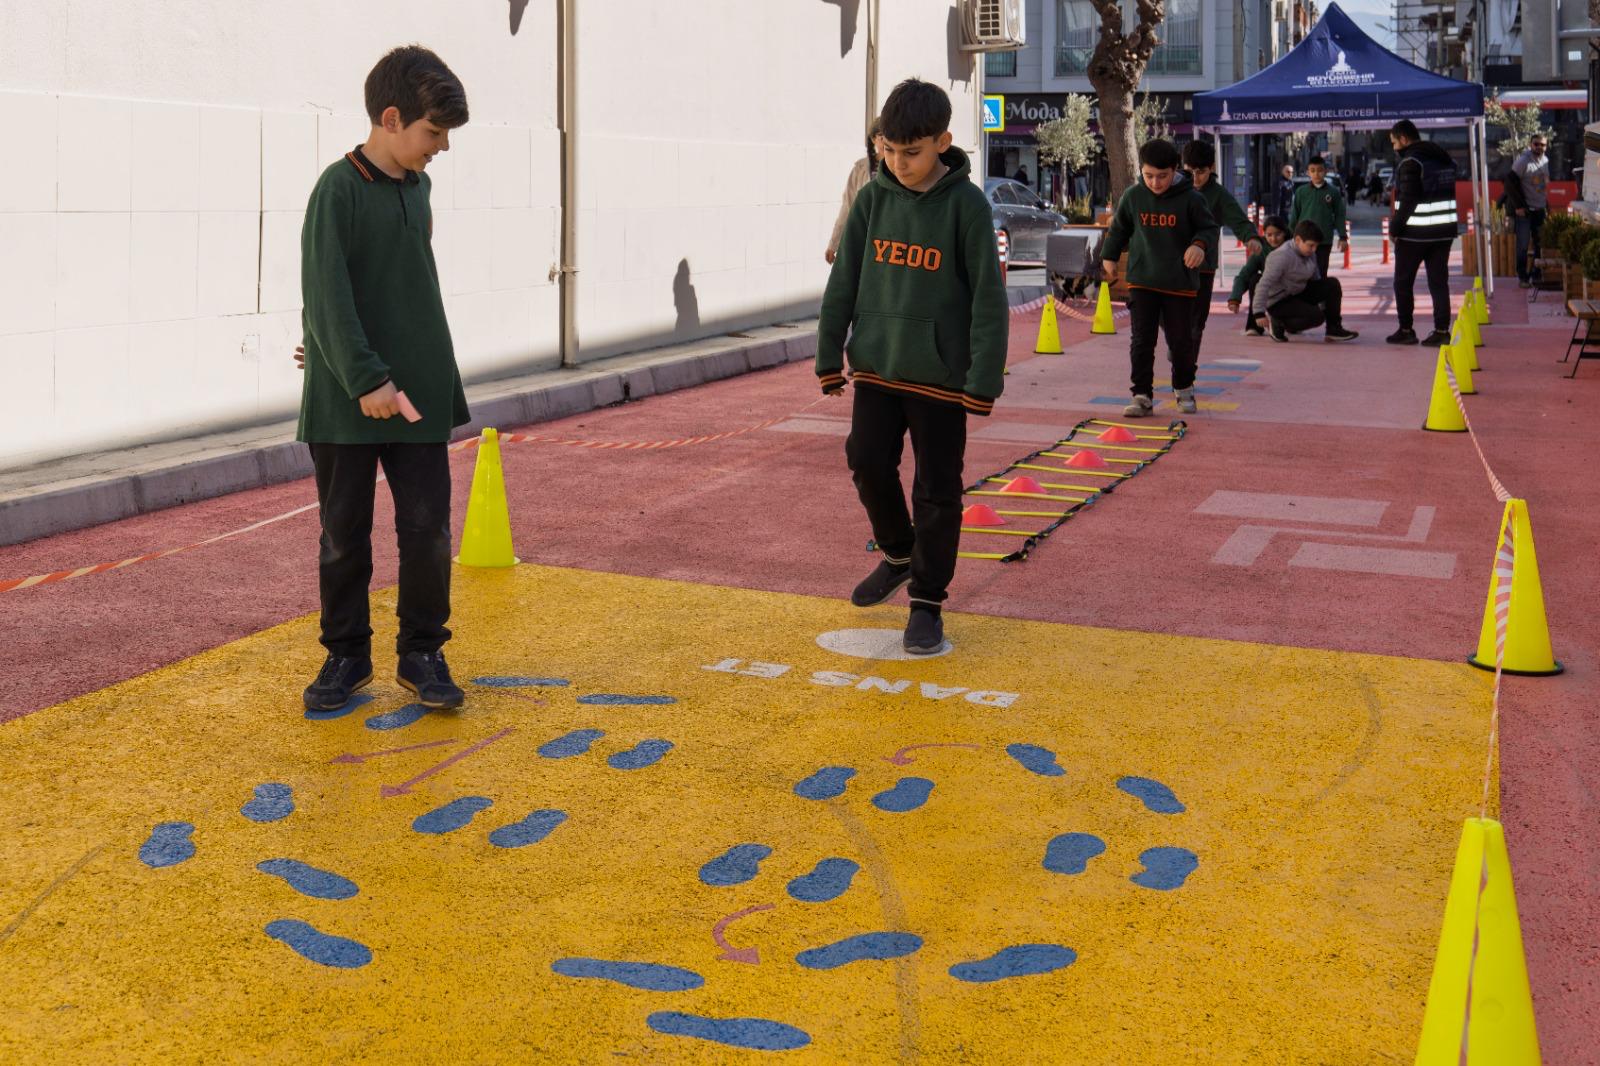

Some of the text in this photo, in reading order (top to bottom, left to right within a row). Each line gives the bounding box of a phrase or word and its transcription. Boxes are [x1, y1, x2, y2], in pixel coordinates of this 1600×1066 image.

[1005, 98, 1060, 120] Moda
[701, 657, 1020, 708] DANS ET
